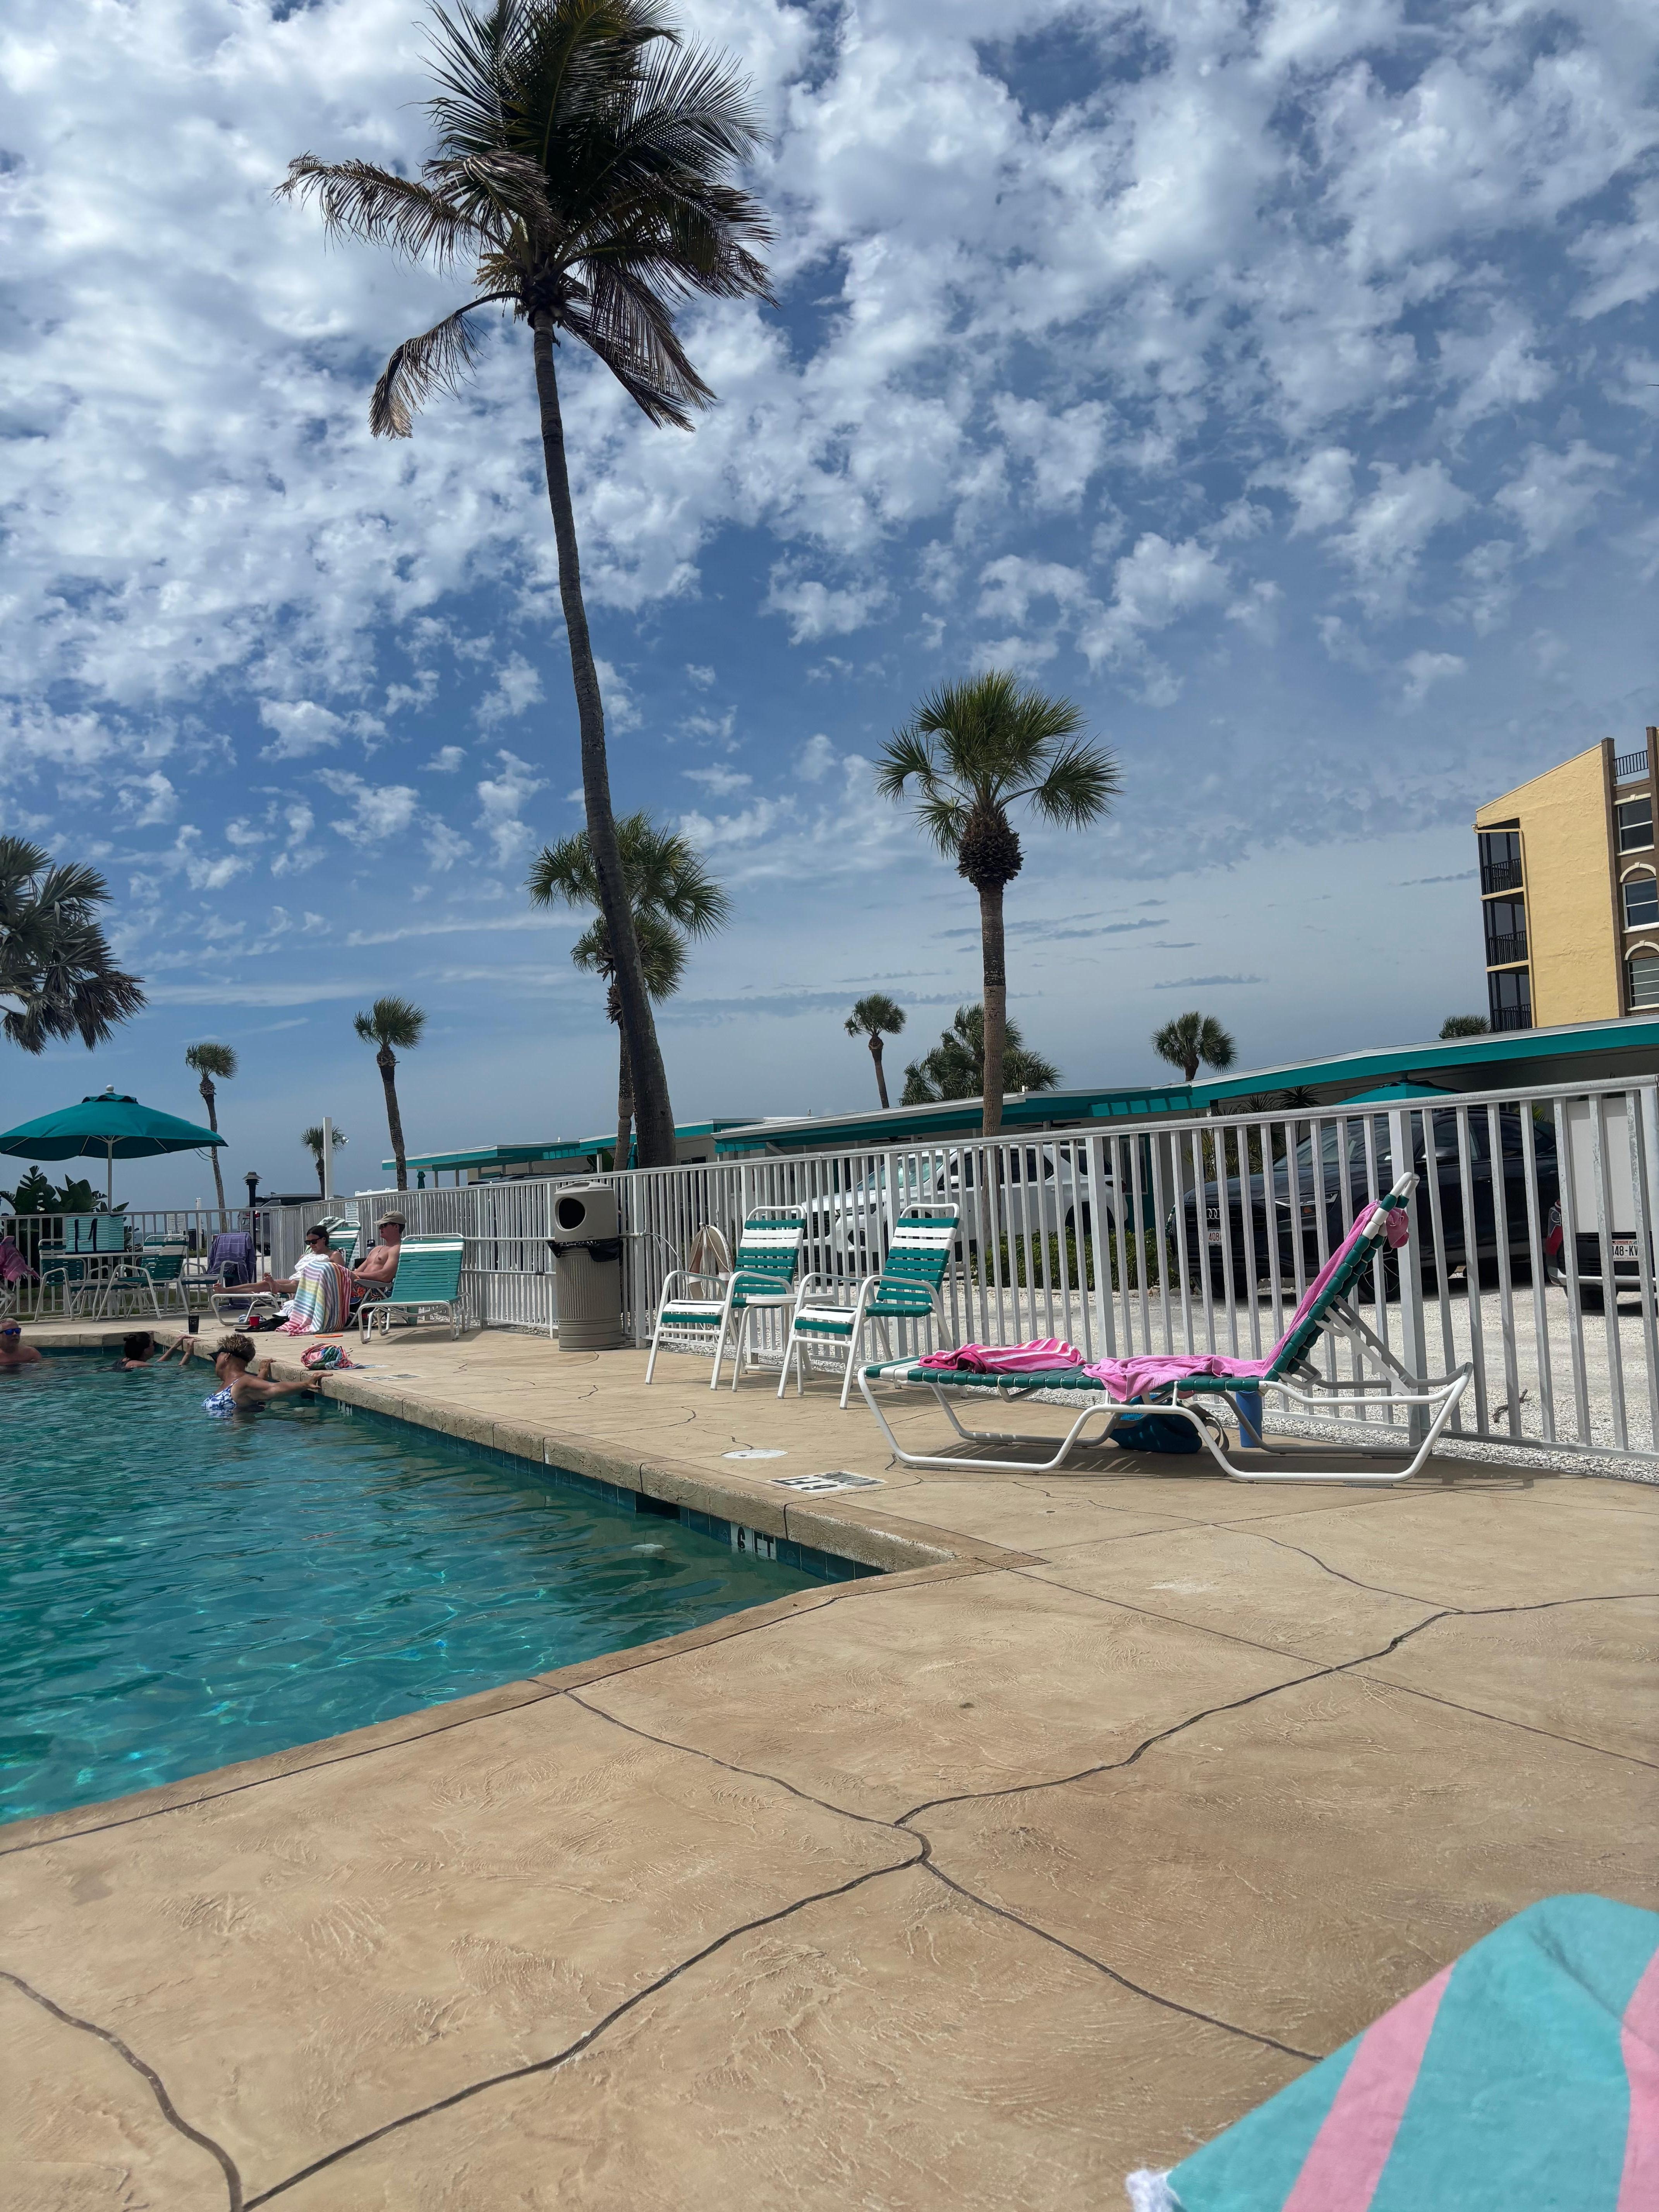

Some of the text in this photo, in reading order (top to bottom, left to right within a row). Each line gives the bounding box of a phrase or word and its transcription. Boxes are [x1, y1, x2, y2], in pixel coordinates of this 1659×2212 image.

[1209, 1233, 1221, 1241] 408
[770, 1477, 822, 1486] FT
[737, 1527, 774, 1557] 6 FT
